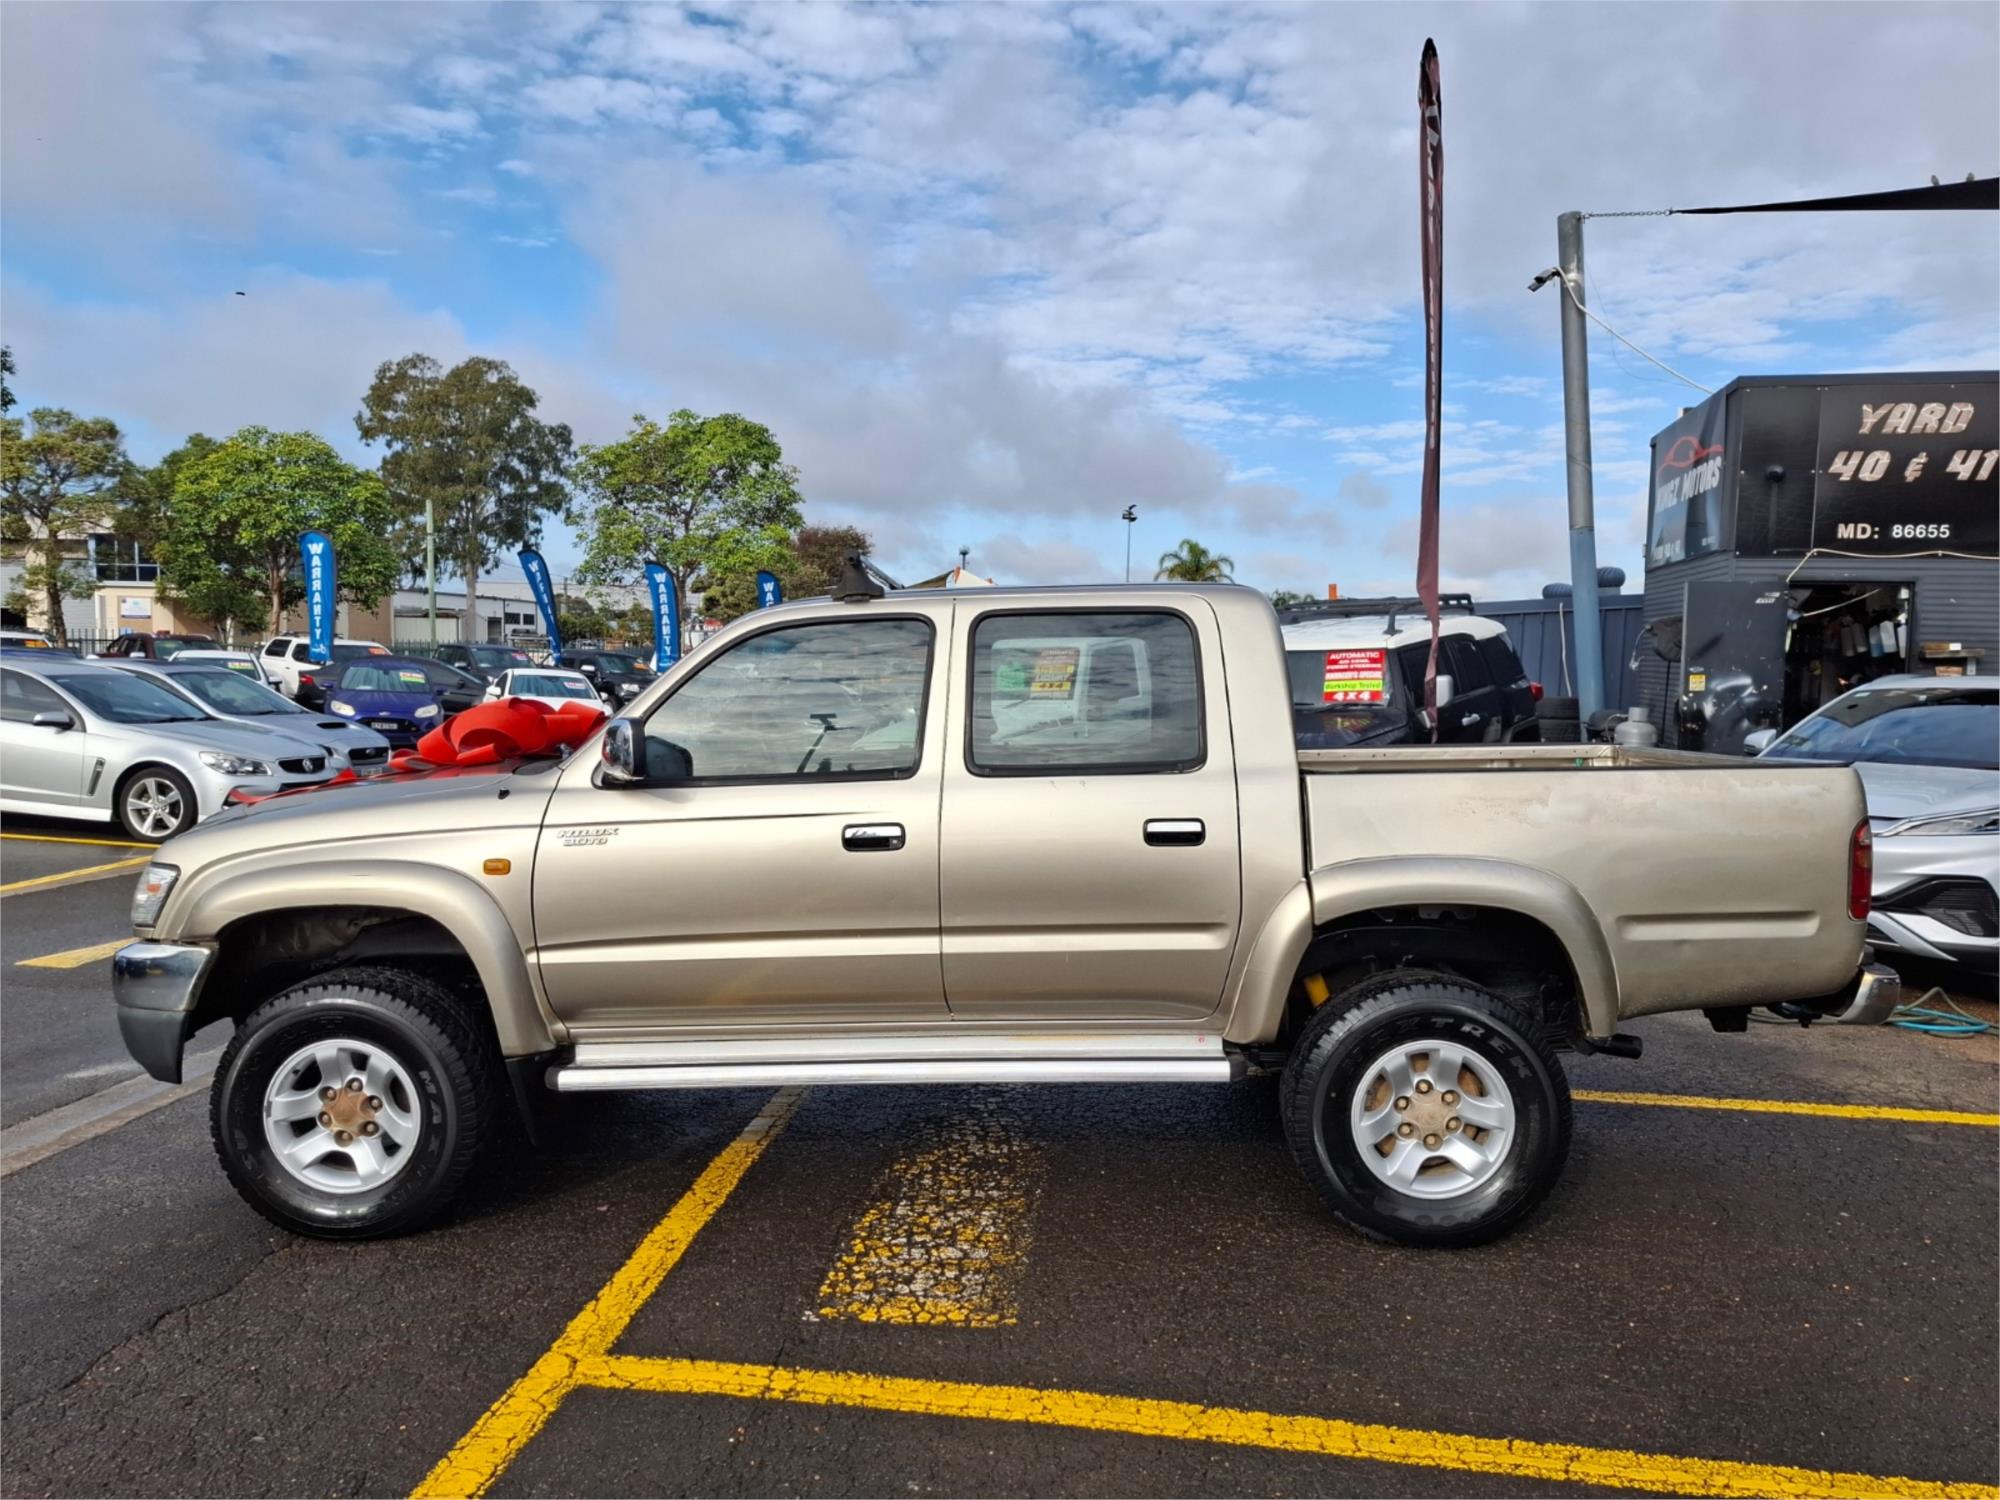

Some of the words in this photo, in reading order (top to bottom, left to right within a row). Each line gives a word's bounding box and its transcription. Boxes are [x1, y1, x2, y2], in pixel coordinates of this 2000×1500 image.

[1858, 402, 1975, 434] YARD
[1681, 456, 1722, 501] MOTORS
[1828, 450, 1891, 482] 40
[1946, 449, 1999, 481] 41
[1837, 523, 1880, 539] MD:
[1892, 524, 1951, 538] 86655
[307, 543, 324, 640] WARRANTY
[653, 572, 672, 656] WARRANTY
